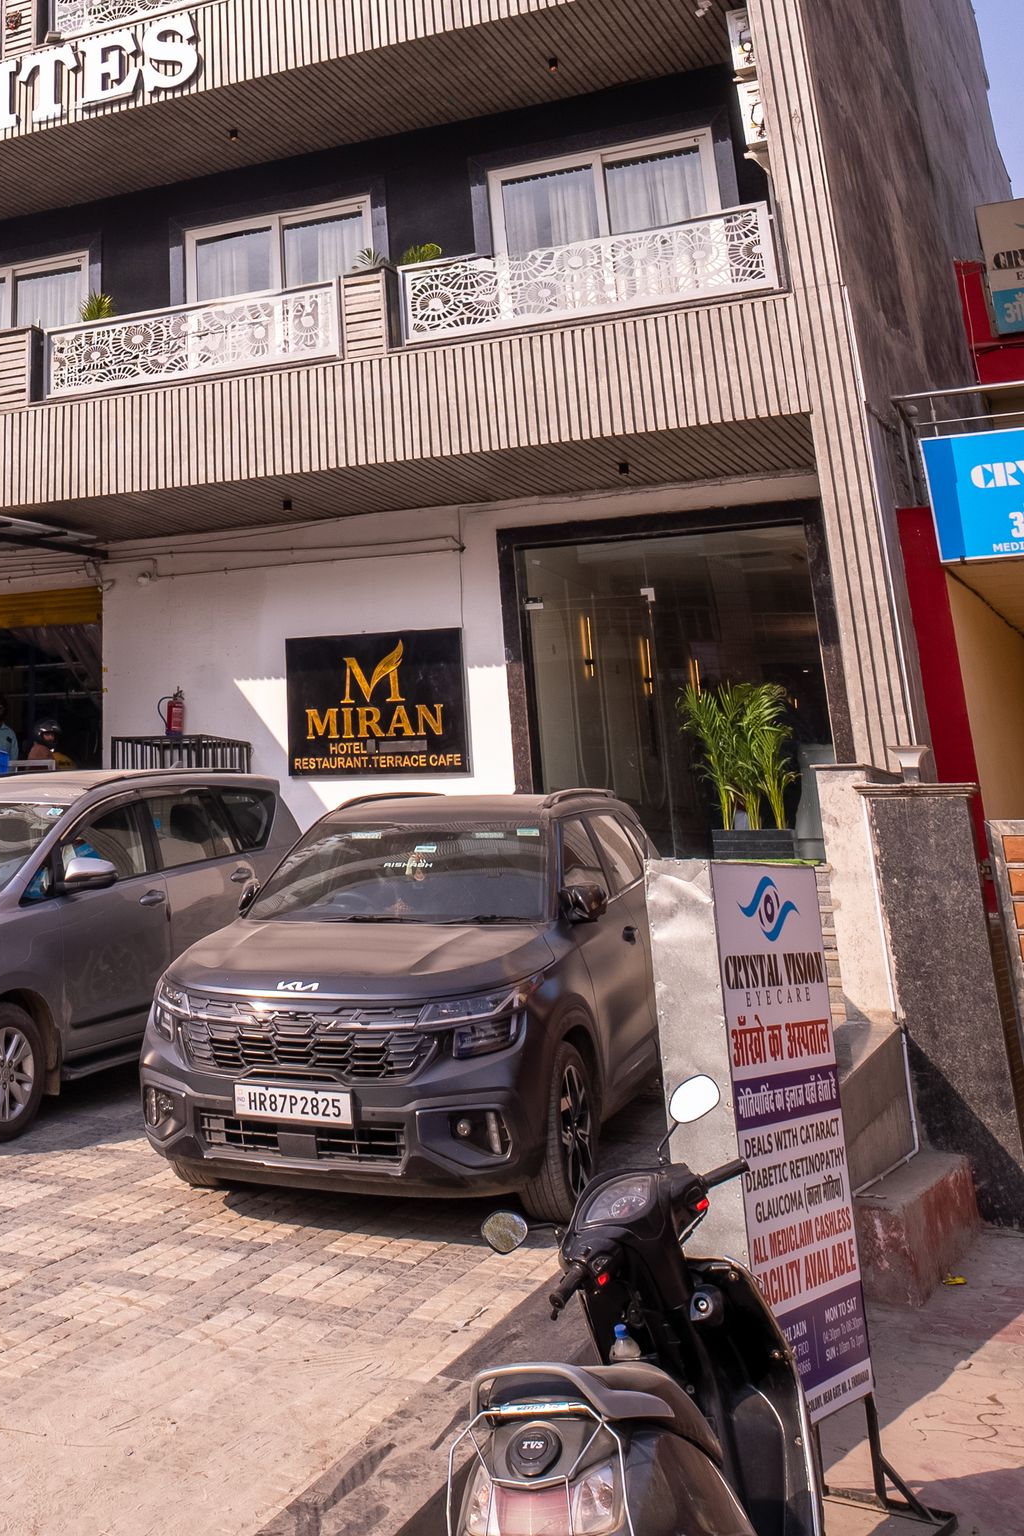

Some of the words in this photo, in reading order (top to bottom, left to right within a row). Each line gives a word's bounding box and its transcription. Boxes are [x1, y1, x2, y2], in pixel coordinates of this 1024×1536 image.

[993, 249, 1024, 271] CR
[305, 703, 443, 739] MIRAN
[329, 741, 367, 755] HOTEL
[429, 753, 462, 766] CAFE
[725, 954, 783, 989] CRYSTAL
[783, 952, 824, 985] VISION
[767, 1024, 784, 1061] का
[785, 1019, 831, 1059] अस्पताल
[248, 1092, 342, 1117] HR87P2825
[774, 1088, 785, 1111] का
[785, 1084, 805, 1112] इलाज
[744, 1133, 773, 1159] DEALS
[773, 1128, 799, 1152] WITH
[800, 1117, 840, 1144] CATARACT
[745, 1164, 788, 1193] DIABETIC
[789, 1146, 845, 1180] RETINOPATHY
[755, 1190, 804, 1224] GLAUCOMA
[753, 1236, 769, 1266] ALL
[769, 1219, 814, 1260] MEDICLAIM
[814, 1206, 852, 1242] CASHLESS
[804, 1238, 857, 1291] AVAILABLE
[824, 1305, 838, 1324] MON
[838, 1302, 847, 1317] TO
[846, 1296, 857, 1314] SAT
[792, 1319, 807, 1339] JAIN
[522, 1441, 544, 1449] TVS
